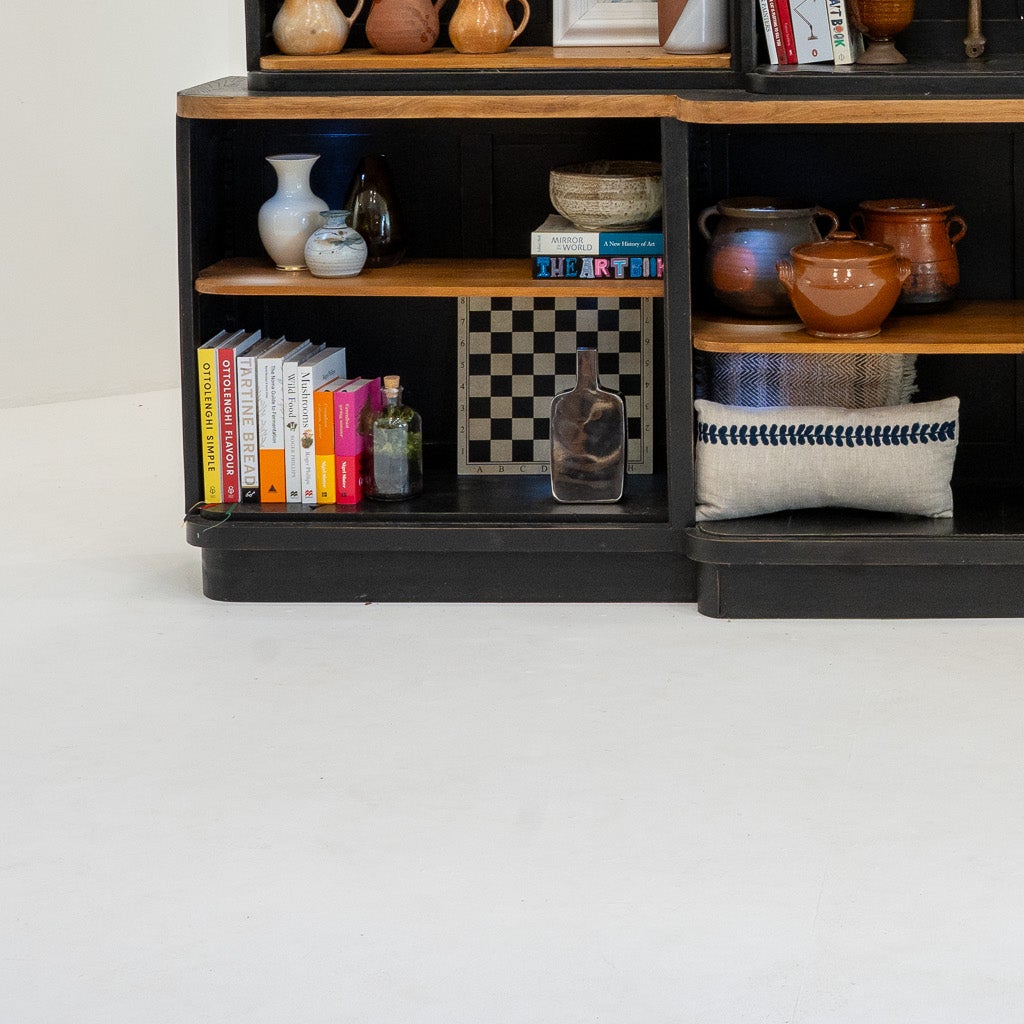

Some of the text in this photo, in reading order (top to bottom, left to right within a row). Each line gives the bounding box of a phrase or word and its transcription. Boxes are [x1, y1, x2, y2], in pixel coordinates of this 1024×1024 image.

[761, 3, 772, 33] PAINTERS
[831, 18, 847, 48] BOOK
[536, 257, 578, 278] THE
[580, 257, 629, 278] ART
[203, 362, 215, 472] OTTOLENGHI SIMPLE
[223, 360, 234, 476] OTTOLENGHI FLAVOUR
[287, 373, 296, 418] Wild Food
[301, 372, 312, 428] Mushrooms
[241, 358, 255, 486] TARTINE BREAD
